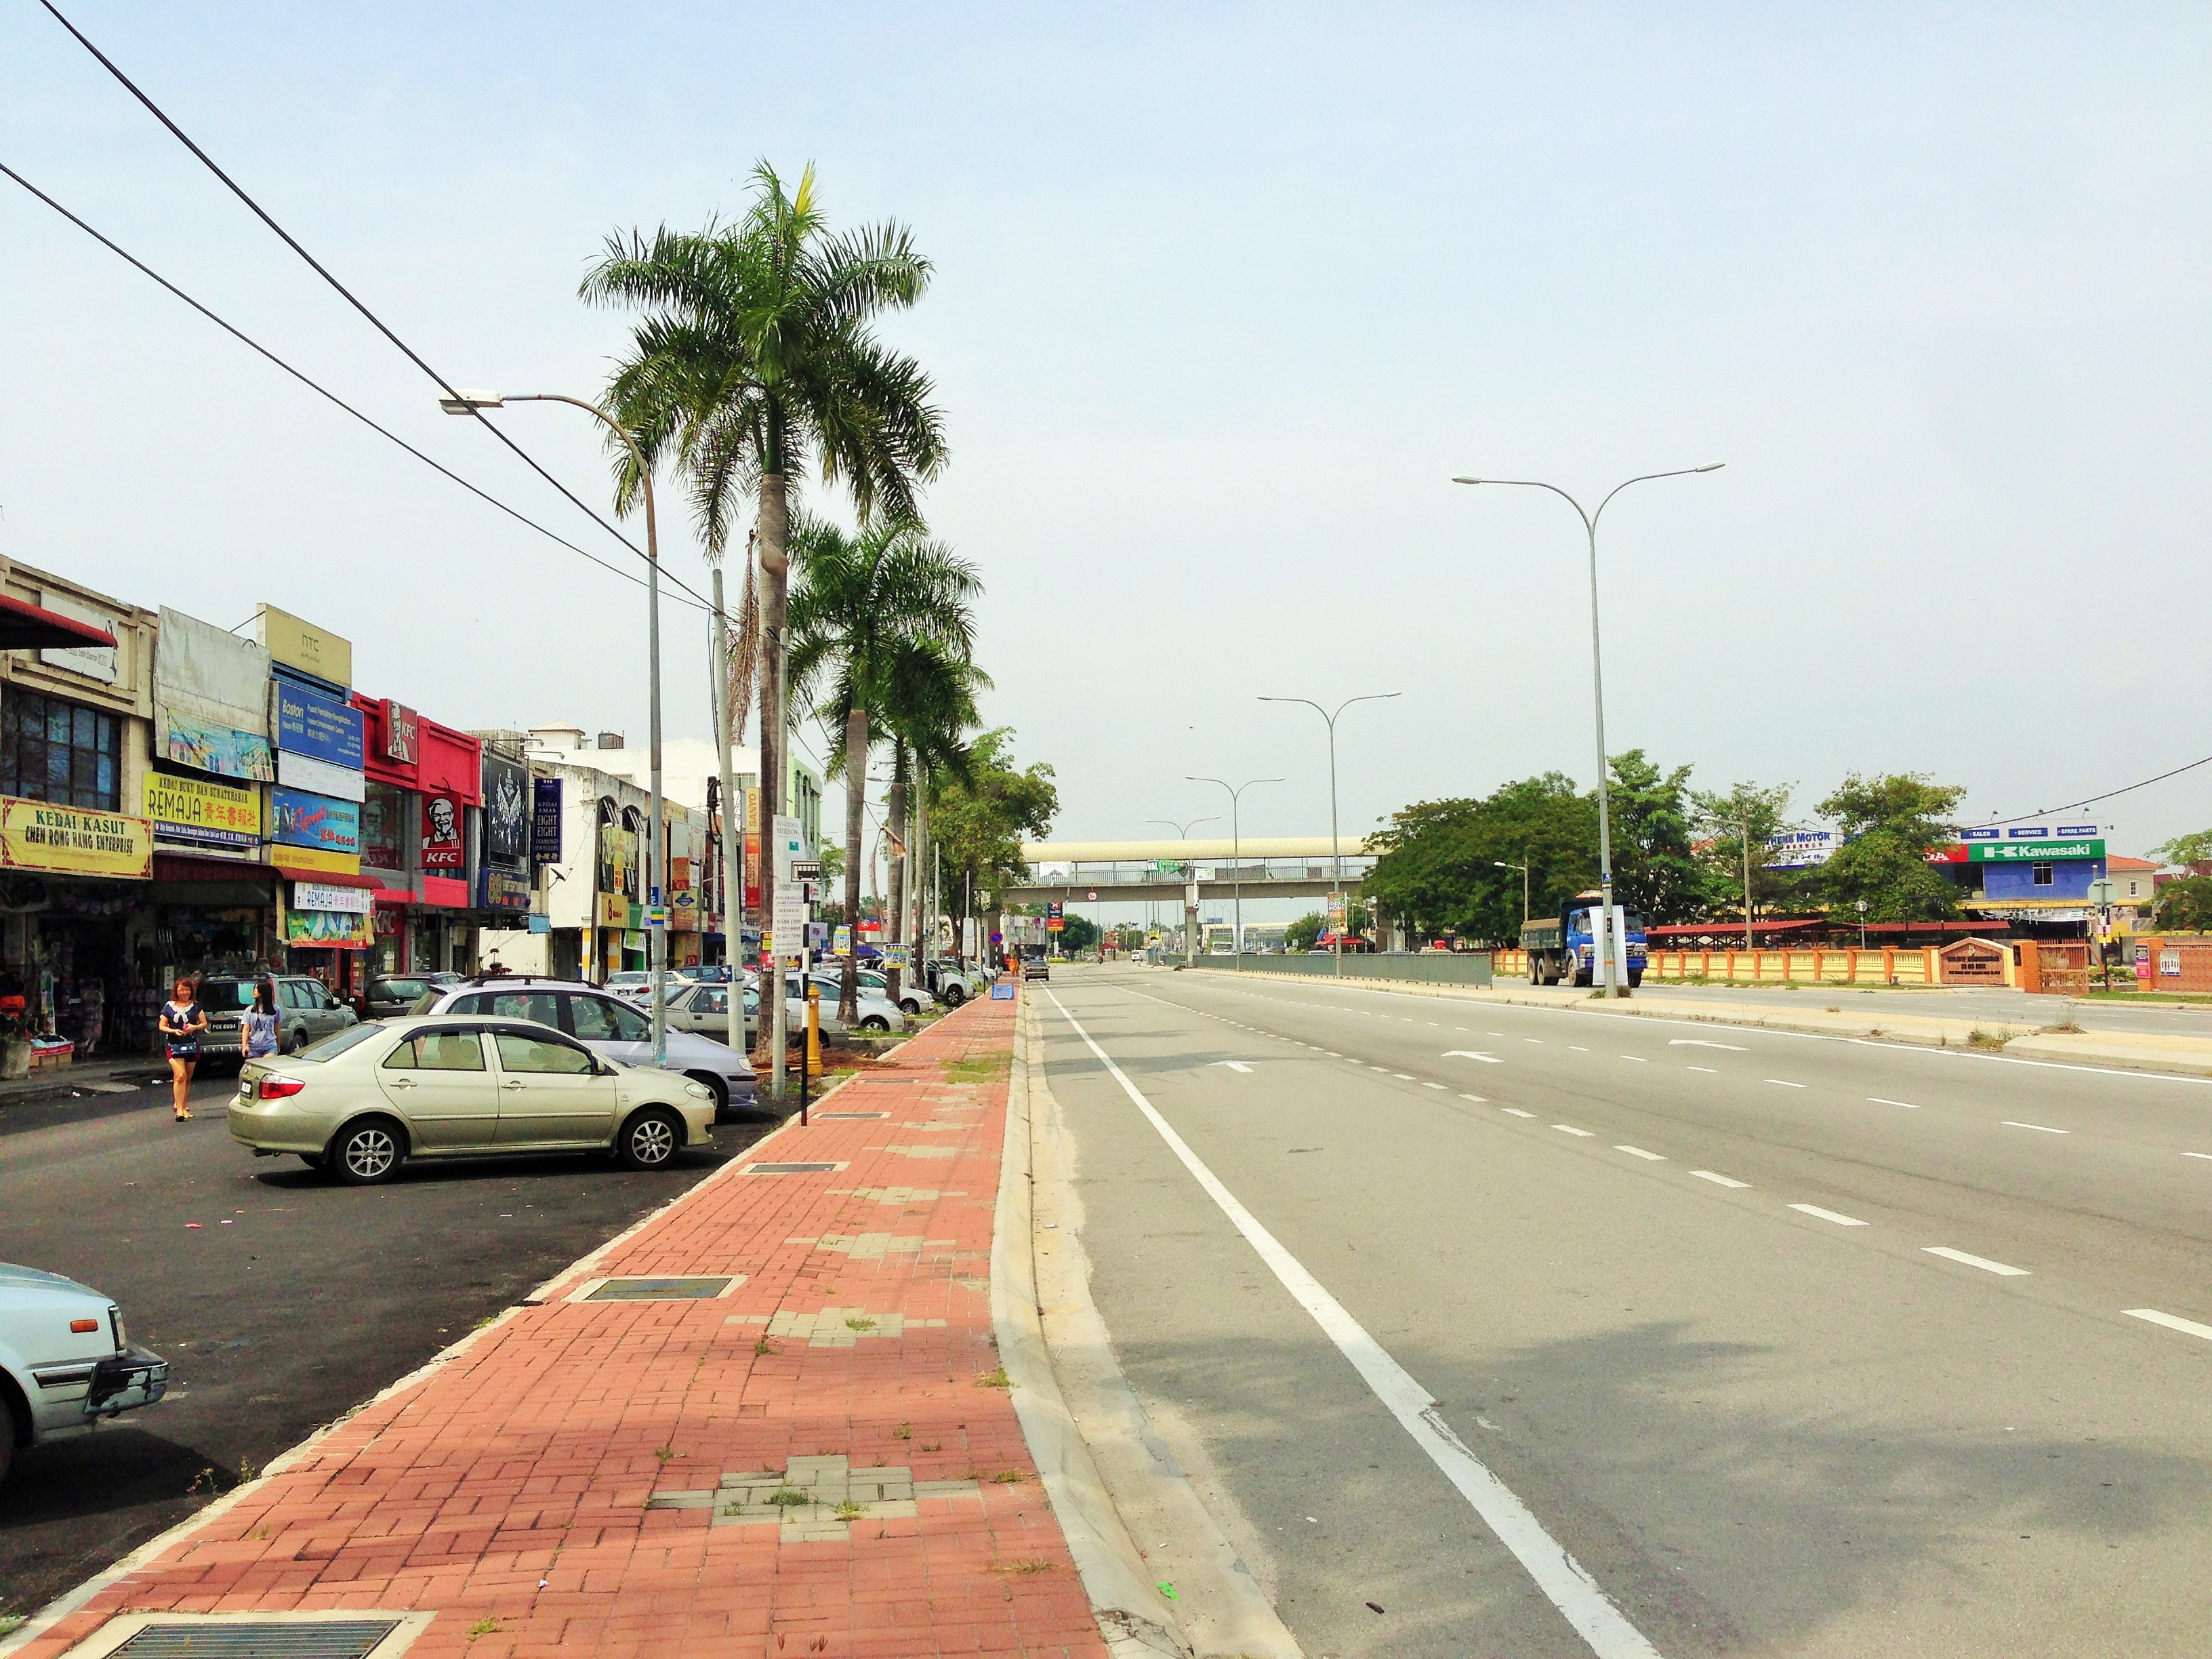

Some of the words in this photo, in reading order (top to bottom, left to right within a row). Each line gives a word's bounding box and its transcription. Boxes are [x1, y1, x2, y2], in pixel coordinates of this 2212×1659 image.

[283, 699, 304, 718] Boston
[402, 722, 415, 739] KFC
[159, 777, 177, 790] KEDAI
[180, 781, 194, 794] BUKU
[197, 784, 208, 796] DAN
[148, 790, 201, 822] REMAJA
[749, 793, 757, 827] SANYO
[35, 810, 77, 829] KEDAI
[83, 817, 125, 835] KASUT
[537, 815, 557, 825] EIGHT
[25, 825, 45, 844] CHEN
[49, 829, 70, 846] RONG
[73, 832, 93, 850] HANG
[96, 835, 133, 854] ENTERPRISE
[537, 826, 557, 837] EIGHT
[1797, 832, 1830, 843] MOTOR
[426, 853, 457, 863] KFC
[2019, 844, 2090, 857] Kawasaki
[307, 891, 333, 907] REMAJA
